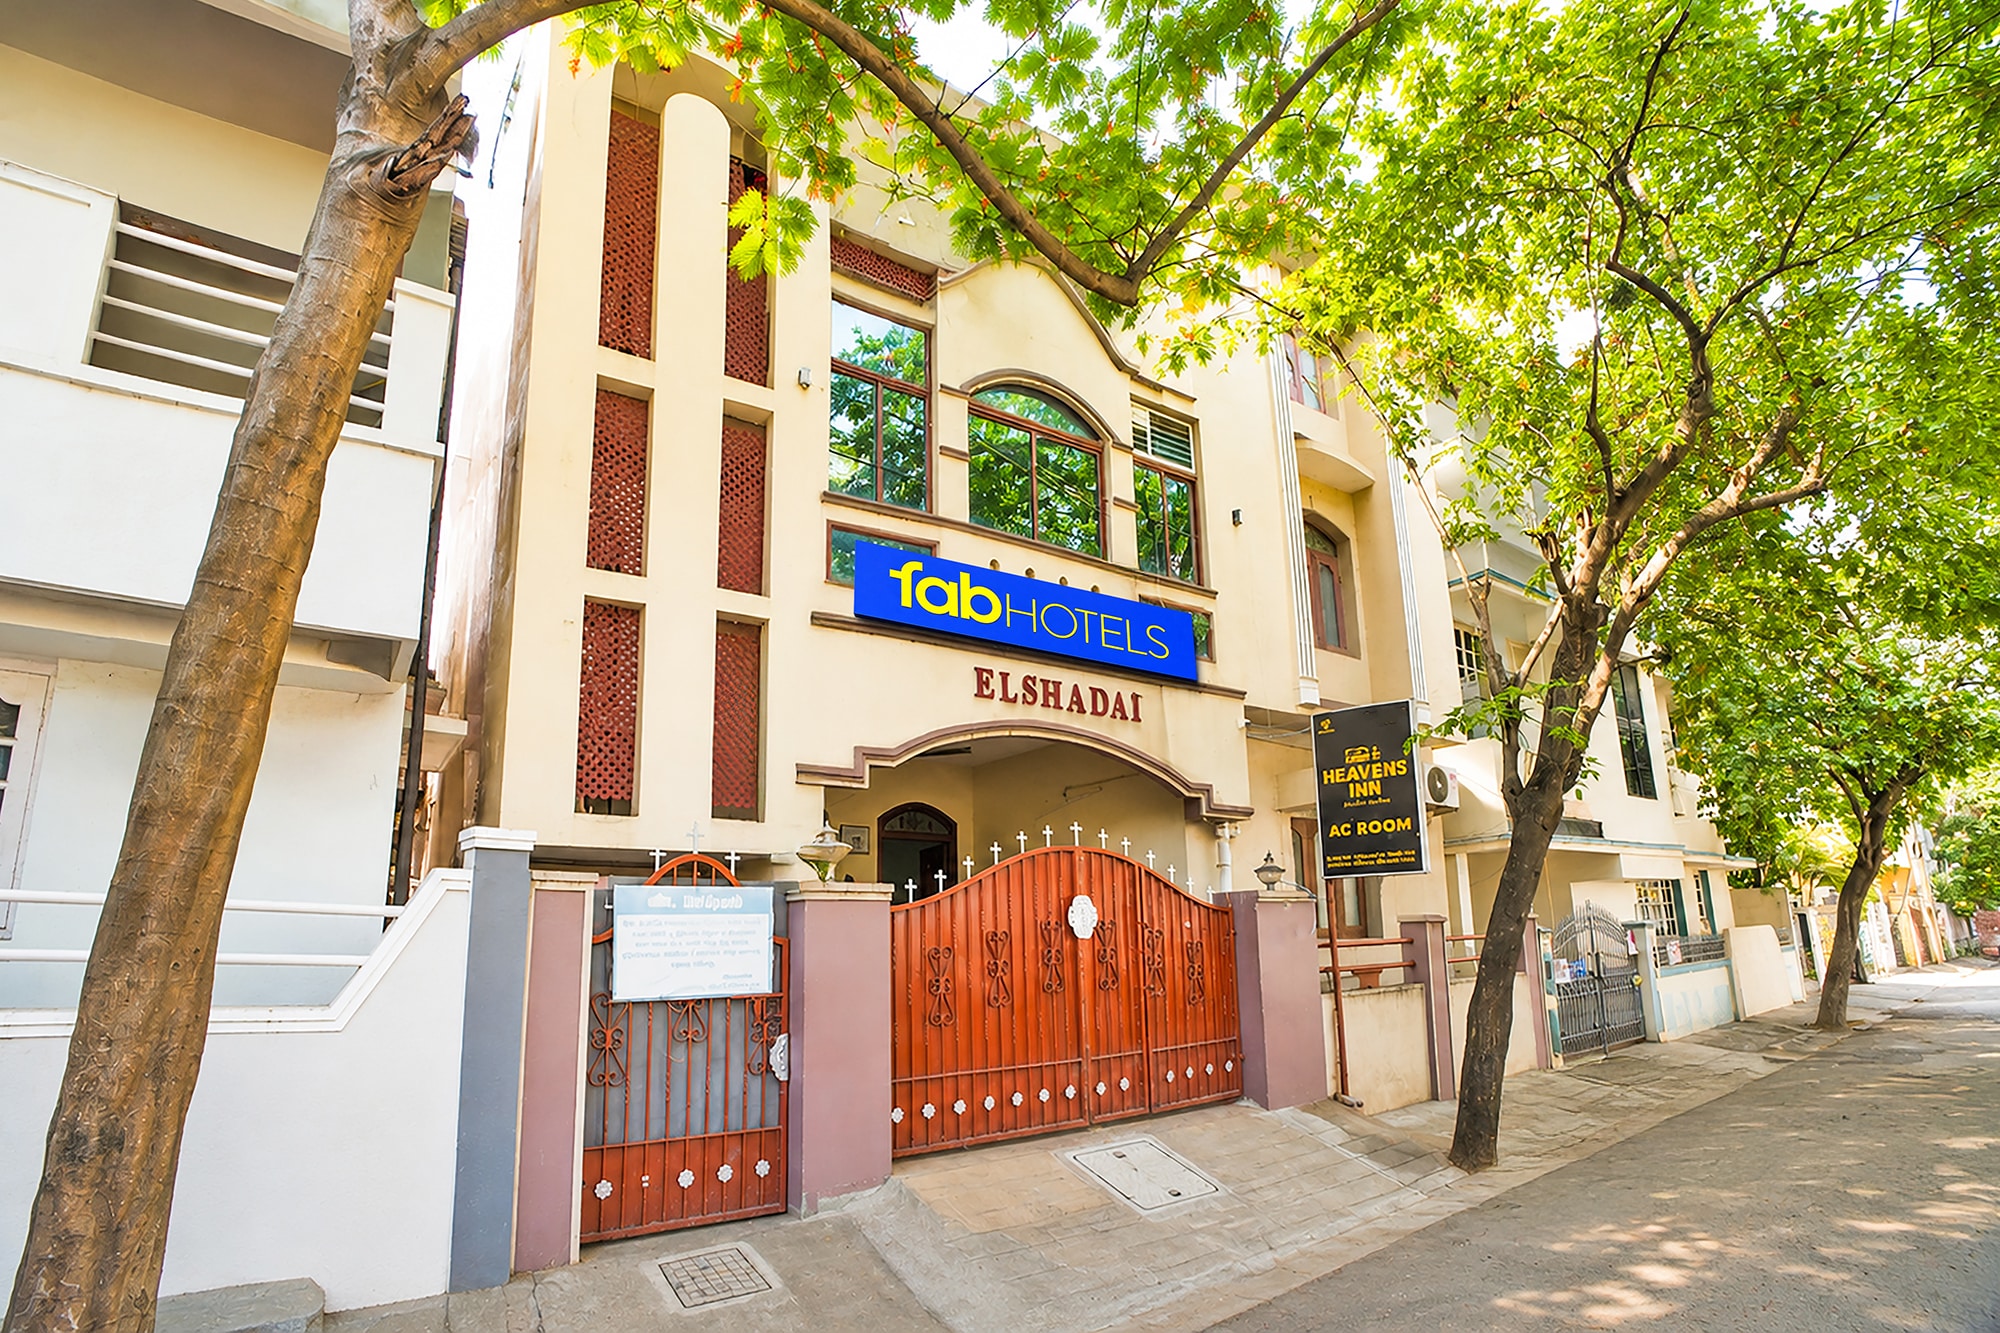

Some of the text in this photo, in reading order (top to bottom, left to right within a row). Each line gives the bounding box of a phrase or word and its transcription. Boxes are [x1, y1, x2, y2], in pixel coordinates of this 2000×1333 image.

[974, 666, 1143, 723] ELSHADAI
[1322, 759, 1408, 785] HEAVENS
[1348, 780, 1382, 798] INN
[1328, 817, 1412, 838] AC ROOM
